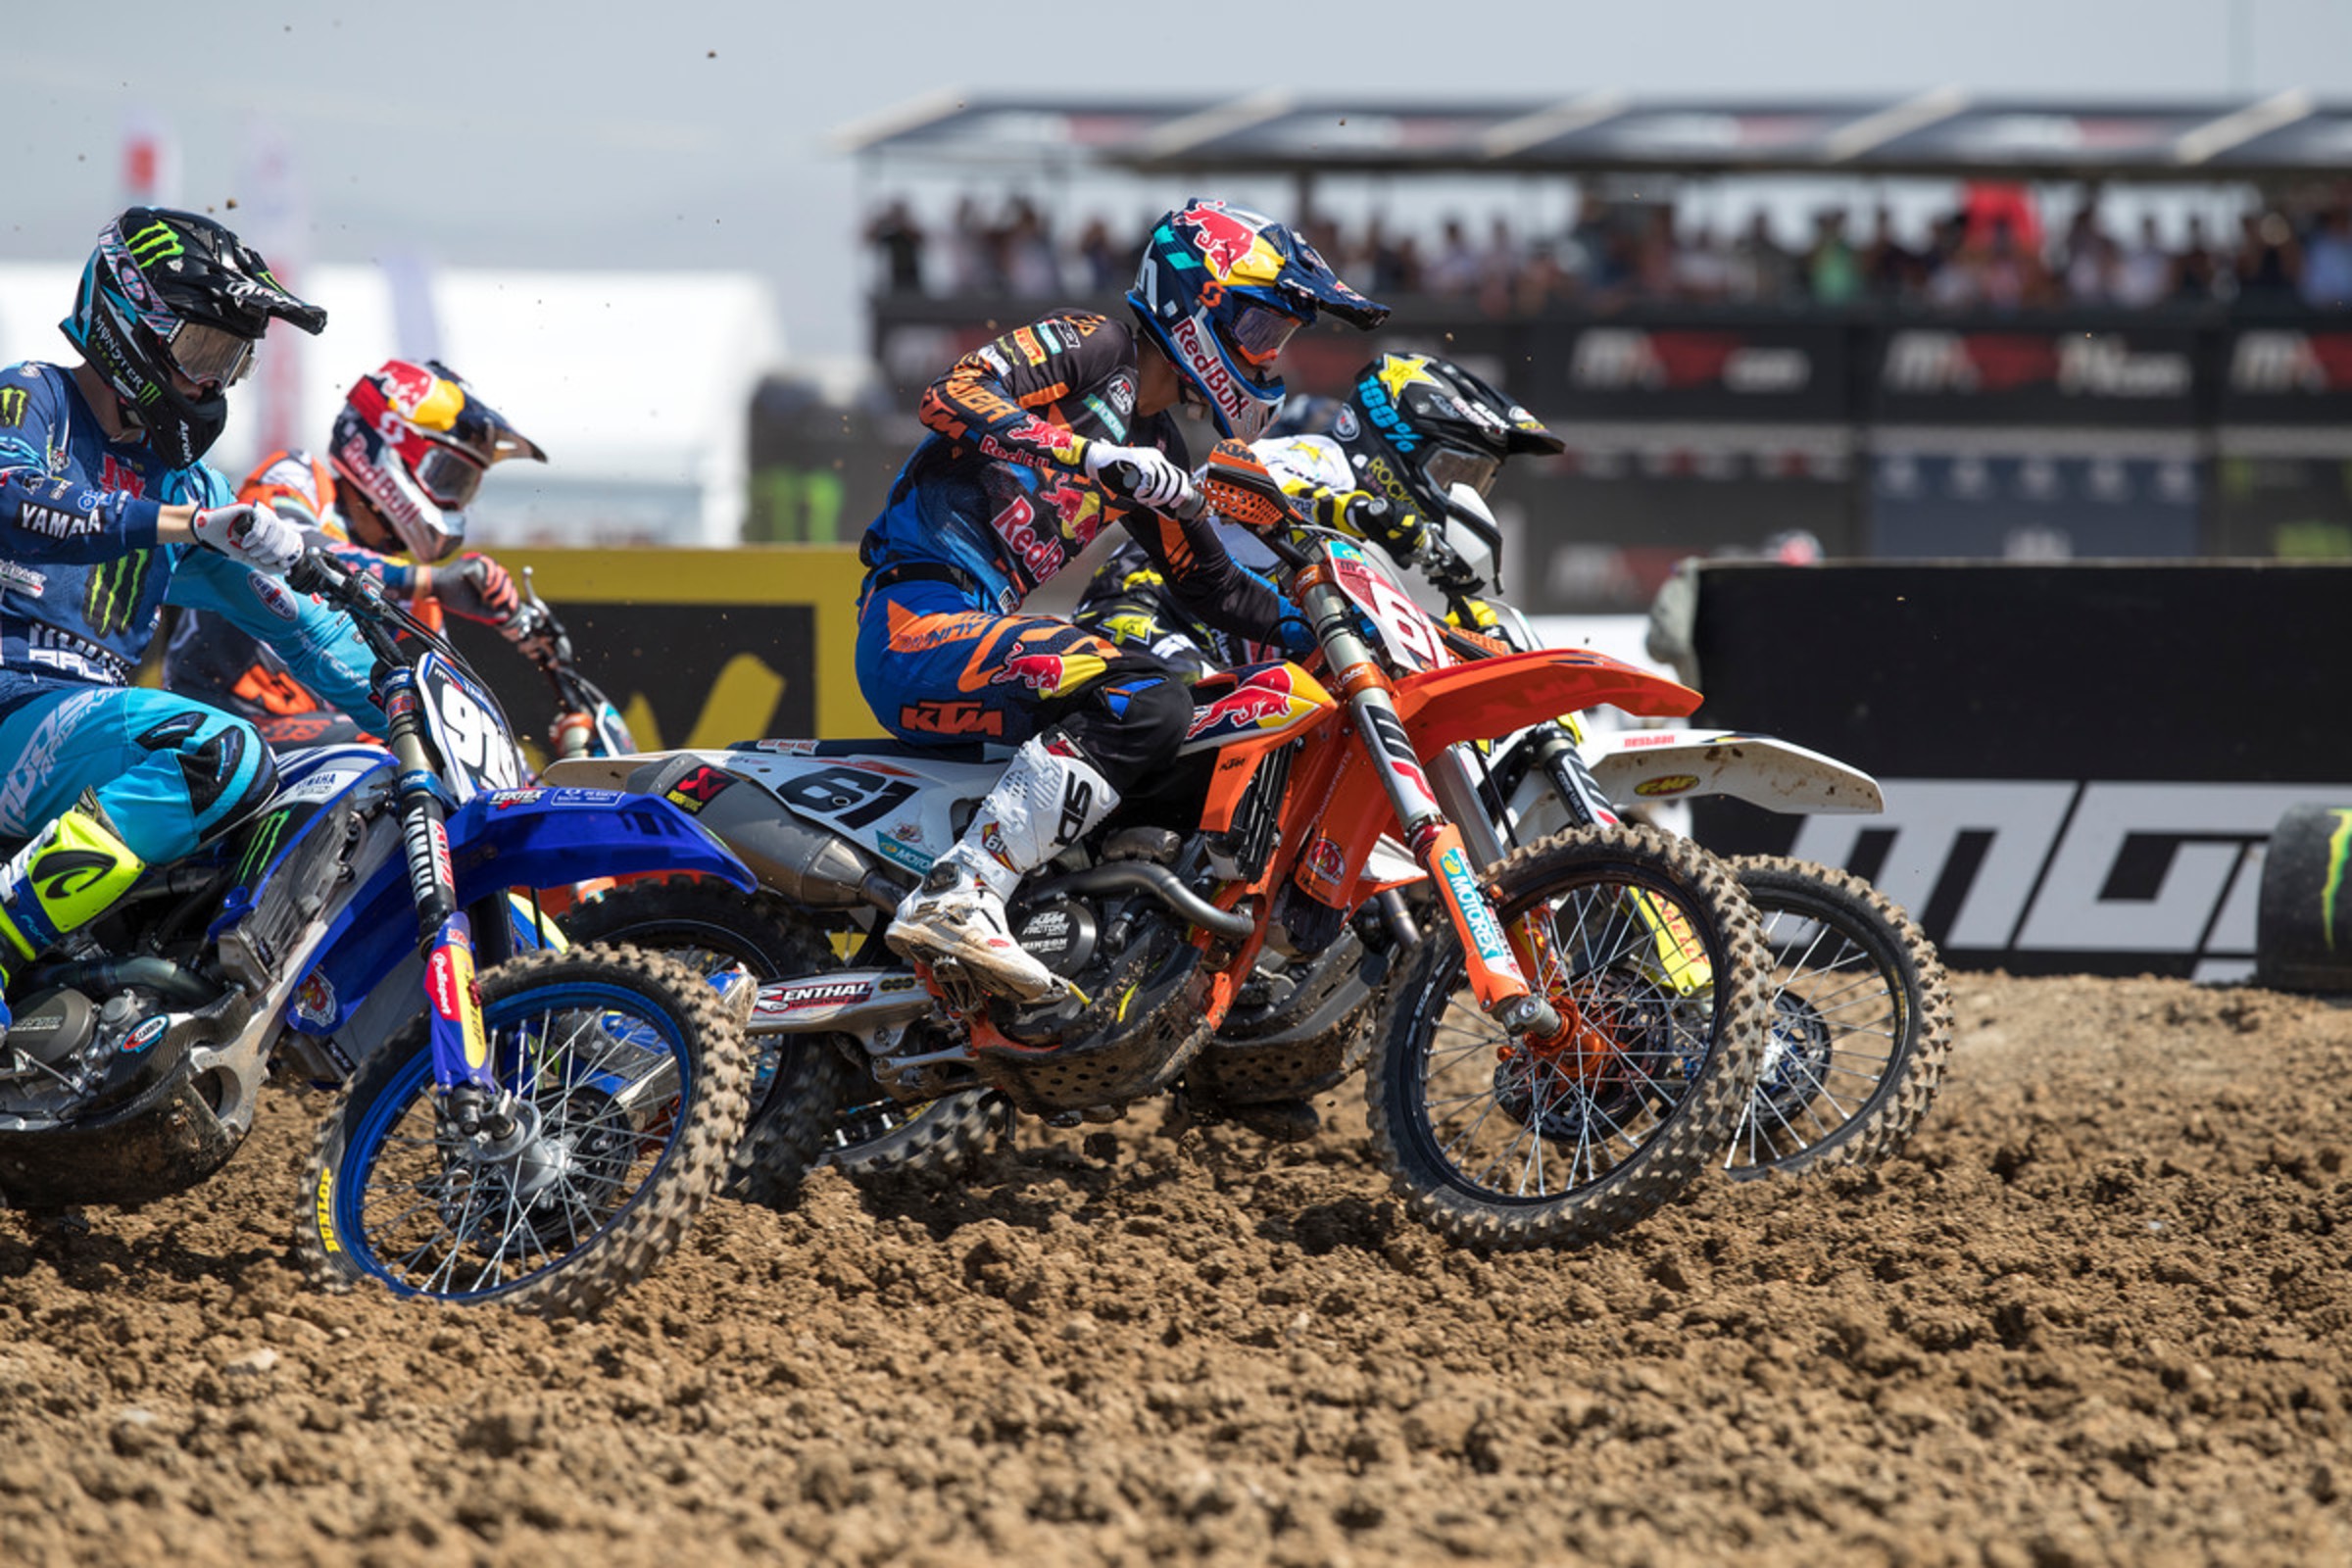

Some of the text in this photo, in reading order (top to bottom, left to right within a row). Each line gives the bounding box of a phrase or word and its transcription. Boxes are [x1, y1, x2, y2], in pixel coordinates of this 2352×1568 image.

[1357, 375, 1423, 453] 100%
[901, 701, 1004, 737] KTM
[776, 767, 920, 831] 61
[403, 806, 434, 908] YAMAHA
[984, 833, 1006, 854] 61
[1450, 875, 1500, 959] MOTOREX
[432, 952, 452, 1015] Polisport
[757, 983, 872, 1013] RENTHAL
[317, 1166, 342, 1253] DUNLOP
